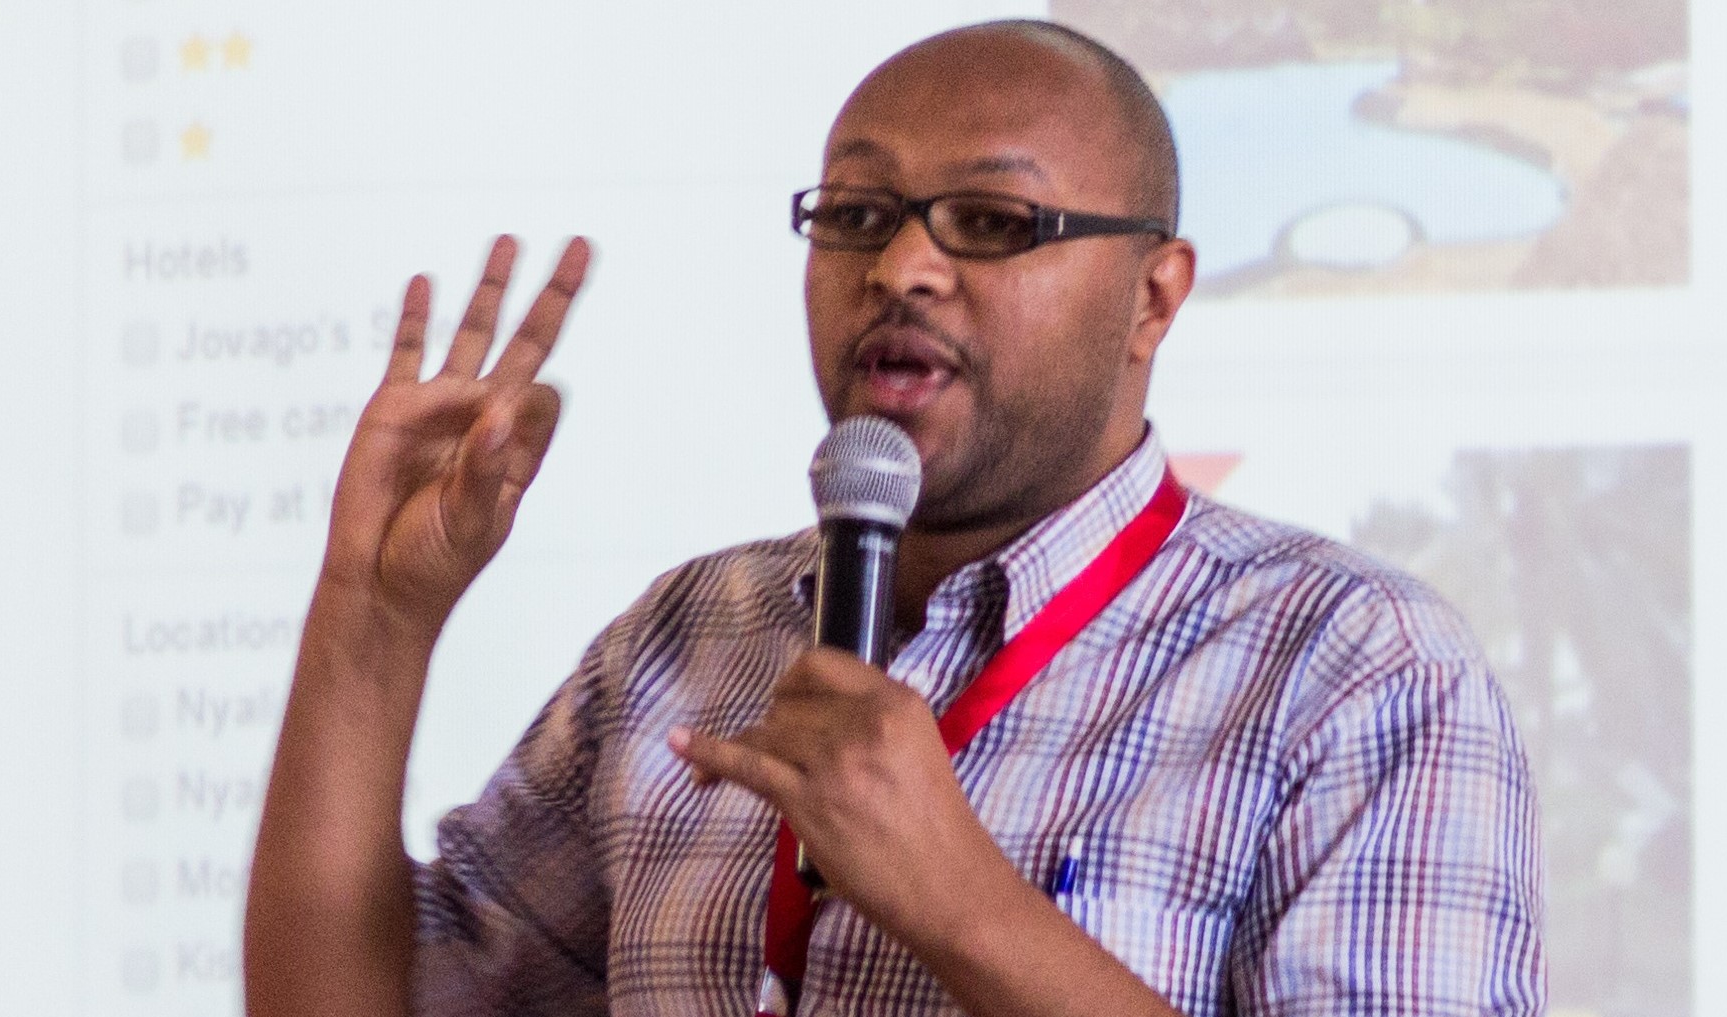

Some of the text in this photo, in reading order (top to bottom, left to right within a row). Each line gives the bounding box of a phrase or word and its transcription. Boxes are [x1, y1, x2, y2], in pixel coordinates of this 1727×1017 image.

[122, 240, 250, 281] Hotels
[177, 311, 351, 367] Jovago's
[177, 400, 361, 443] Free can
[177, 483, 250, 534] Pay
[270, 483, 304, 522] at
[123, 613, 295, 657] Location
[177, 772, 262, 824] Nya
